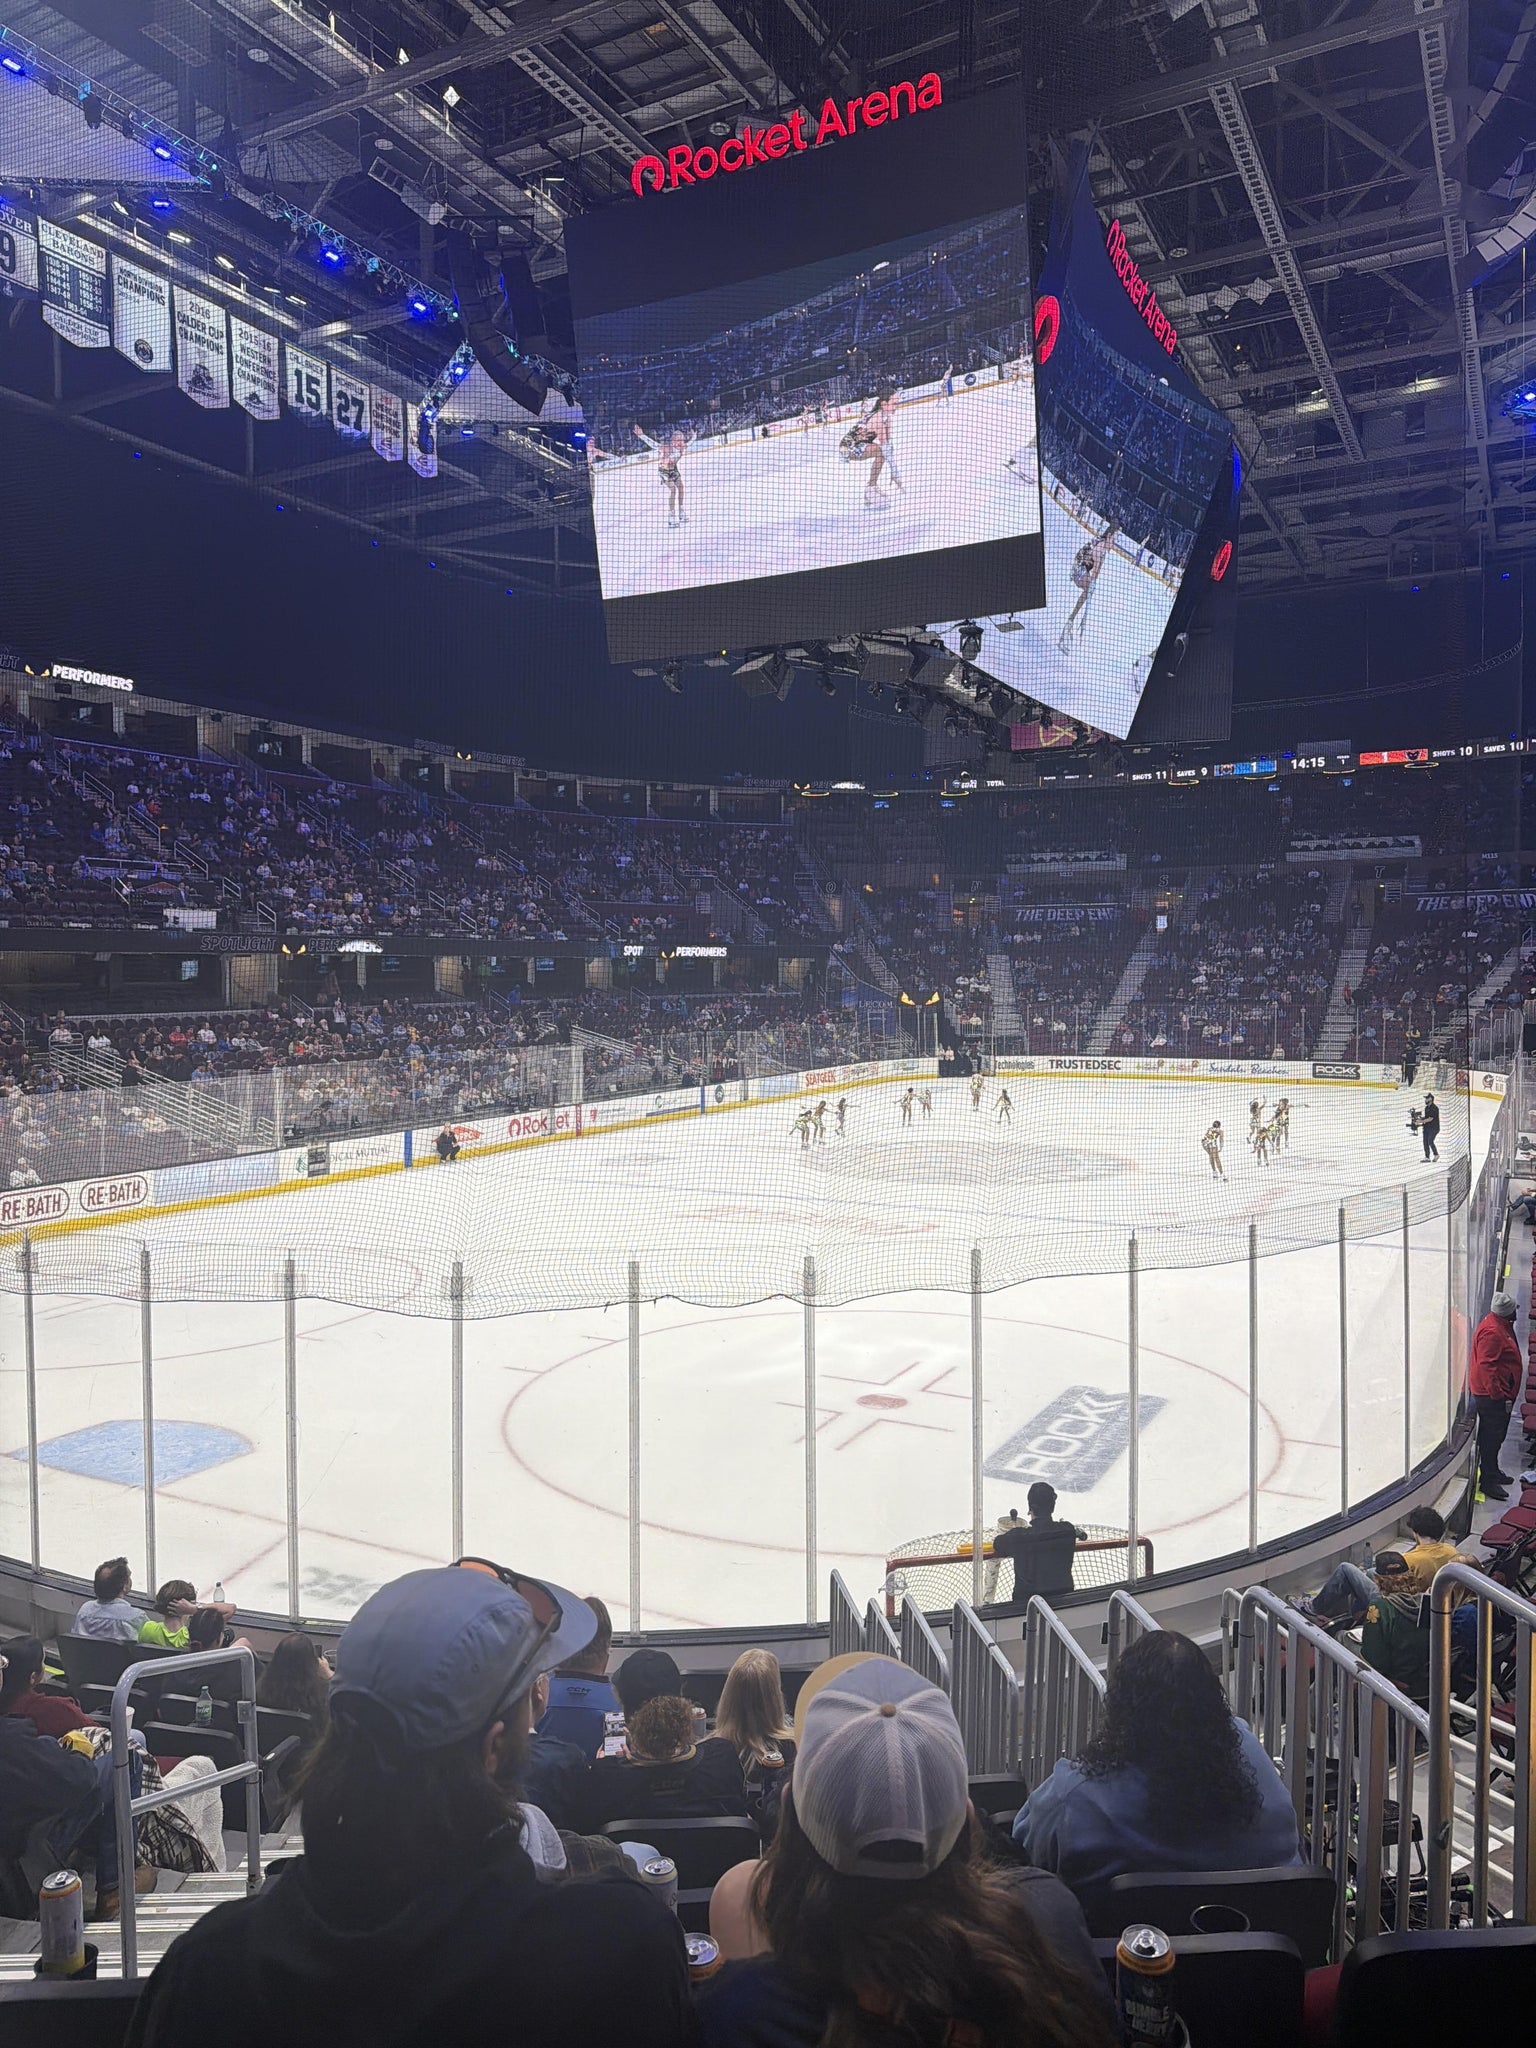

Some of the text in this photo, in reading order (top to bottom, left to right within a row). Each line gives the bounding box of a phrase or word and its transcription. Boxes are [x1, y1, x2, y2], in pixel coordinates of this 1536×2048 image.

[667, 72, 942, 188] Rocket Arena
[41, 222, 104, 260] CLEVELAND
[53, 239, 95, 266] BARONS
[117, 275, 166, 306] CHAMPIONS
[1112, 231, 1177, 355] Rocket Arena
[189, 301, 211, 319] 2016
[177, 310, 224, 340] CALDER CUP
[178, 326, 224, 356] CHAMPIONS
[239, 344, 272, 366] WESTERN
[235, 355, 277, 381] CONFERENCE
[237, 368, 276, 394] CHAMPIONS
[294, 367, 321, 412] 15
[336, 389, 365, 433] 27
[52, 664, 134, 692] PERFORMERS
[1381, 751, 1389, 764] 1
[1432, 749, 1456, 758] SHOTS
[1459, 746, 1473, 756] 10
[1483, 744, 1506, 753] SAVES
[1509, 741, 1523, 751] 10
[1250, 762, 1257, 772] 1
[1290, 756, 1326, 769] 14:15
[1132, 767, 1208, 781] SHOTS 11 SAVES 9
[1015, 908, 1043, 922] THE
[1046, 907, 1085, 922] DEEP
[1416, 897, 1451, 912] THE
[200, 935, 384, 953] SPOTLIGHT PERFORMERS
[675, 946, 728, 957] PERFORMERS
[1049, 1059, 1122, 1071] TRUSTEDSEC
[805, 1069, 836, 1087] SEATGEEK
